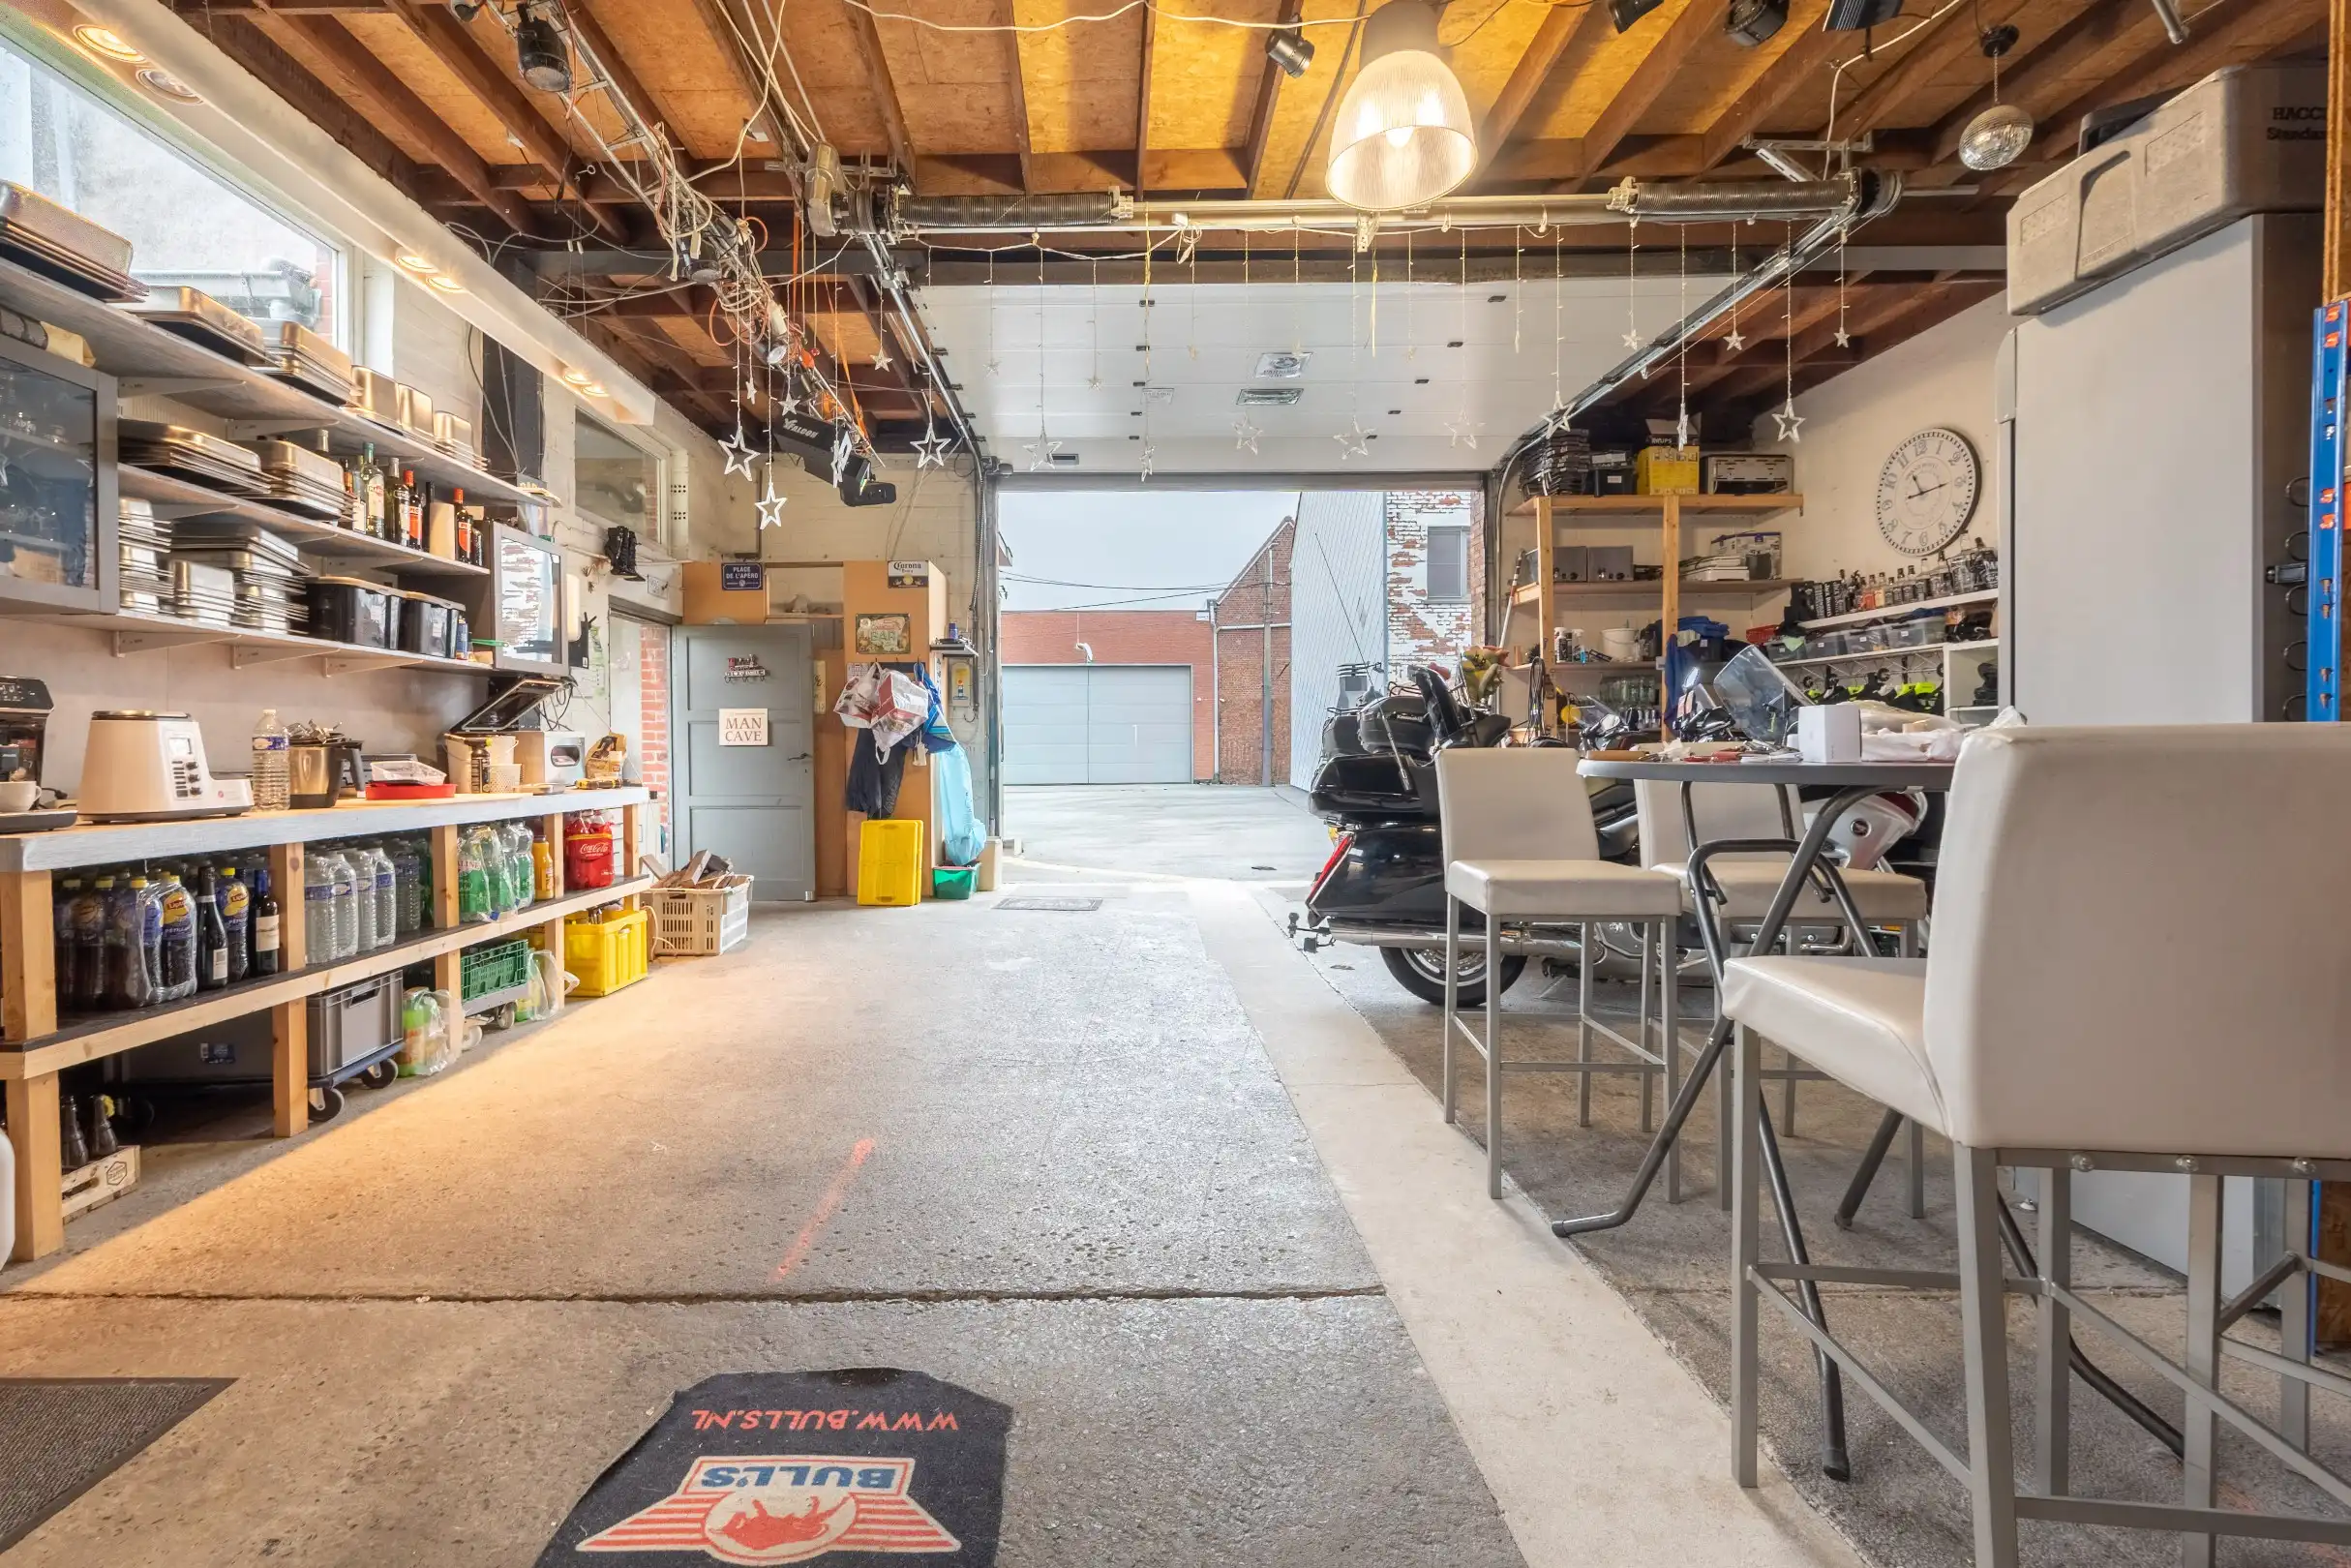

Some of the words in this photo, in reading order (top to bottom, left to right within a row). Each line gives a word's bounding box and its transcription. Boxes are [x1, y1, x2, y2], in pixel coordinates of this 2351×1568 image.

[726, 717, 762, 729] MAN
[725, 731, 762, 741] CAVE
[691, 1409, 960, 1432] WWW.BULLS.NL
[700, 1465, 897, 1490] BULL'S
